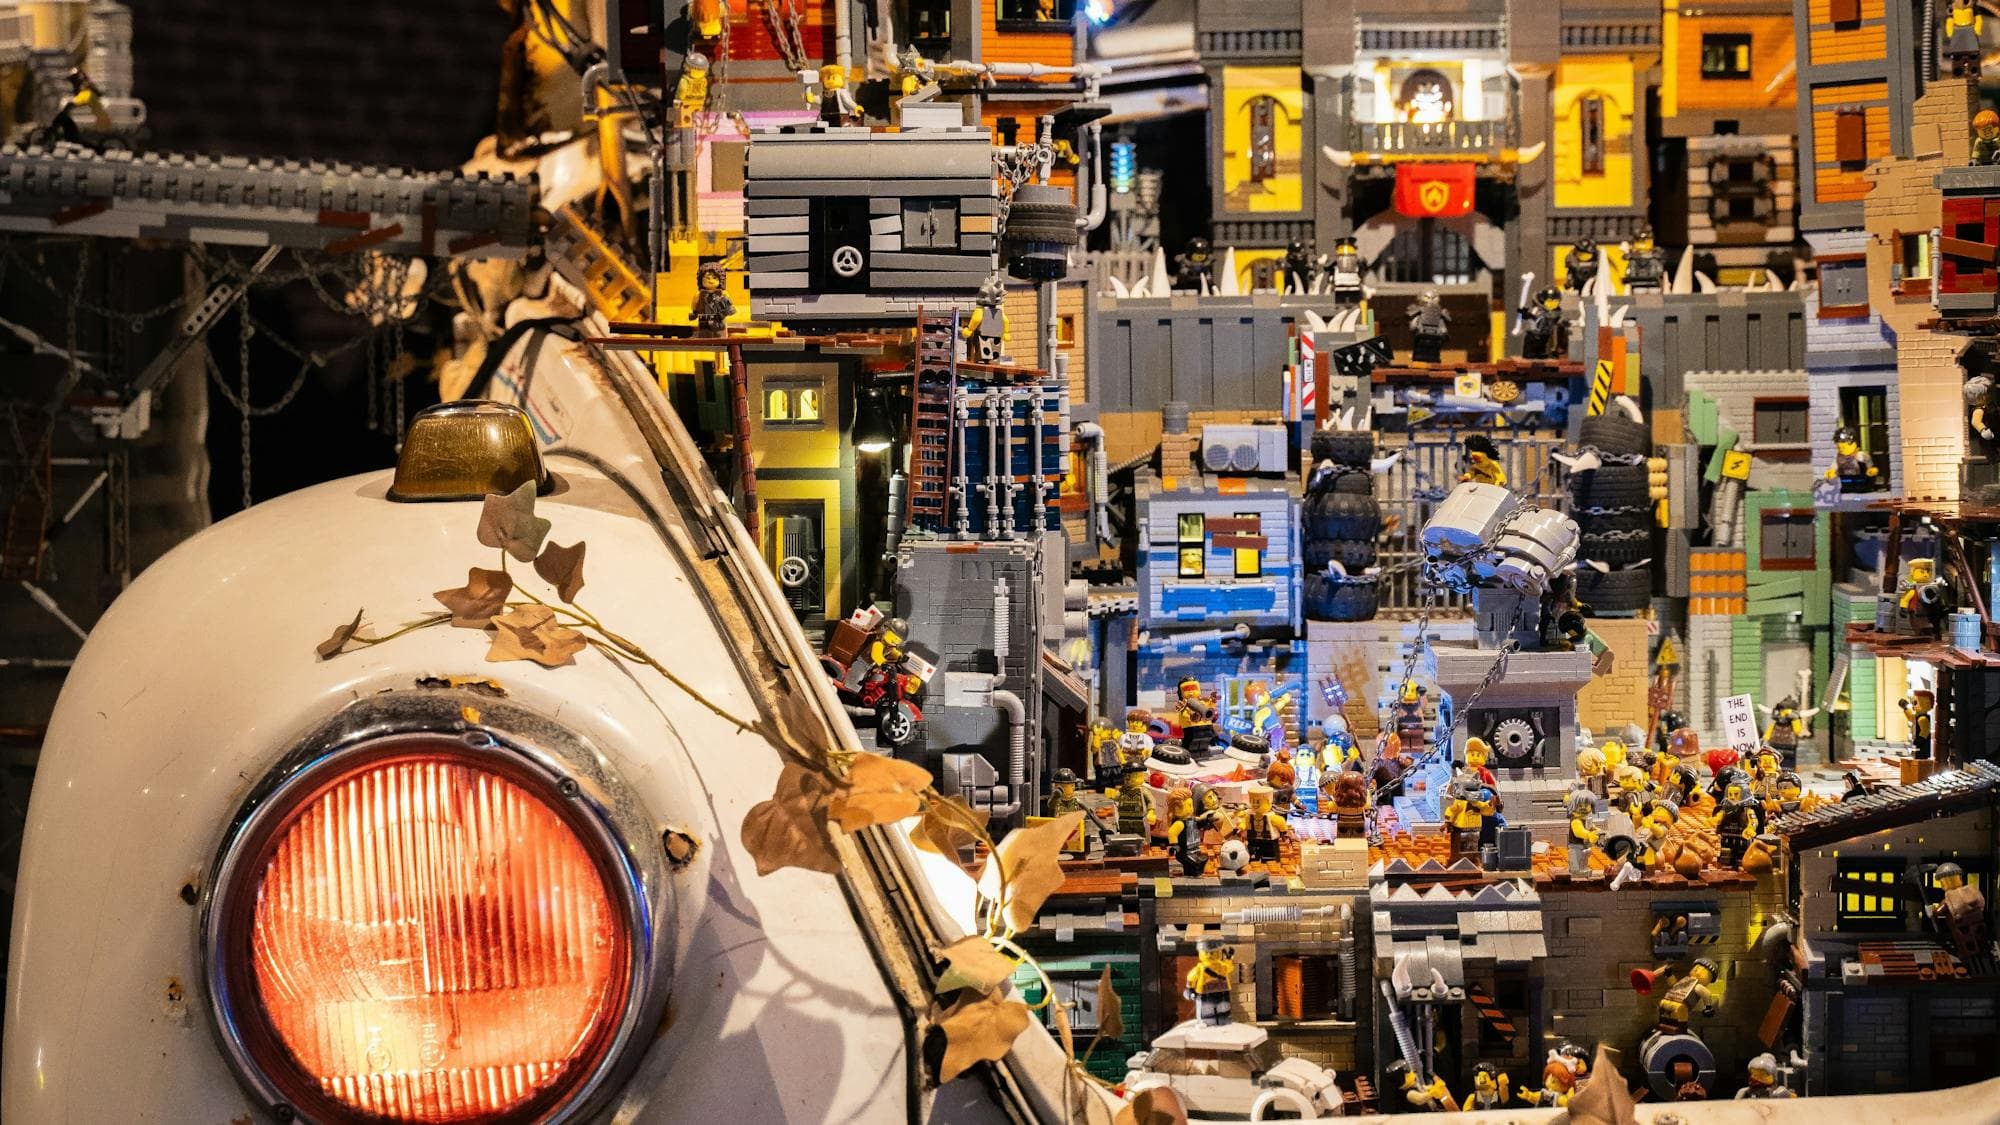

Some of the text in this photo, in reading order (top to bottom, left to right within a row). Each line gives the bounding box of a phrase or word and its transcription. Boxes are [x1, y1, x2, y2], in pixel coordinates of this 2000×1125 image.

[1727, 698, 1745, 708] THE
[1729, 713, 1748, 724] END
[1737, 728, 1746, 738] IS
[1732, 741, 1756, 752] NOW
